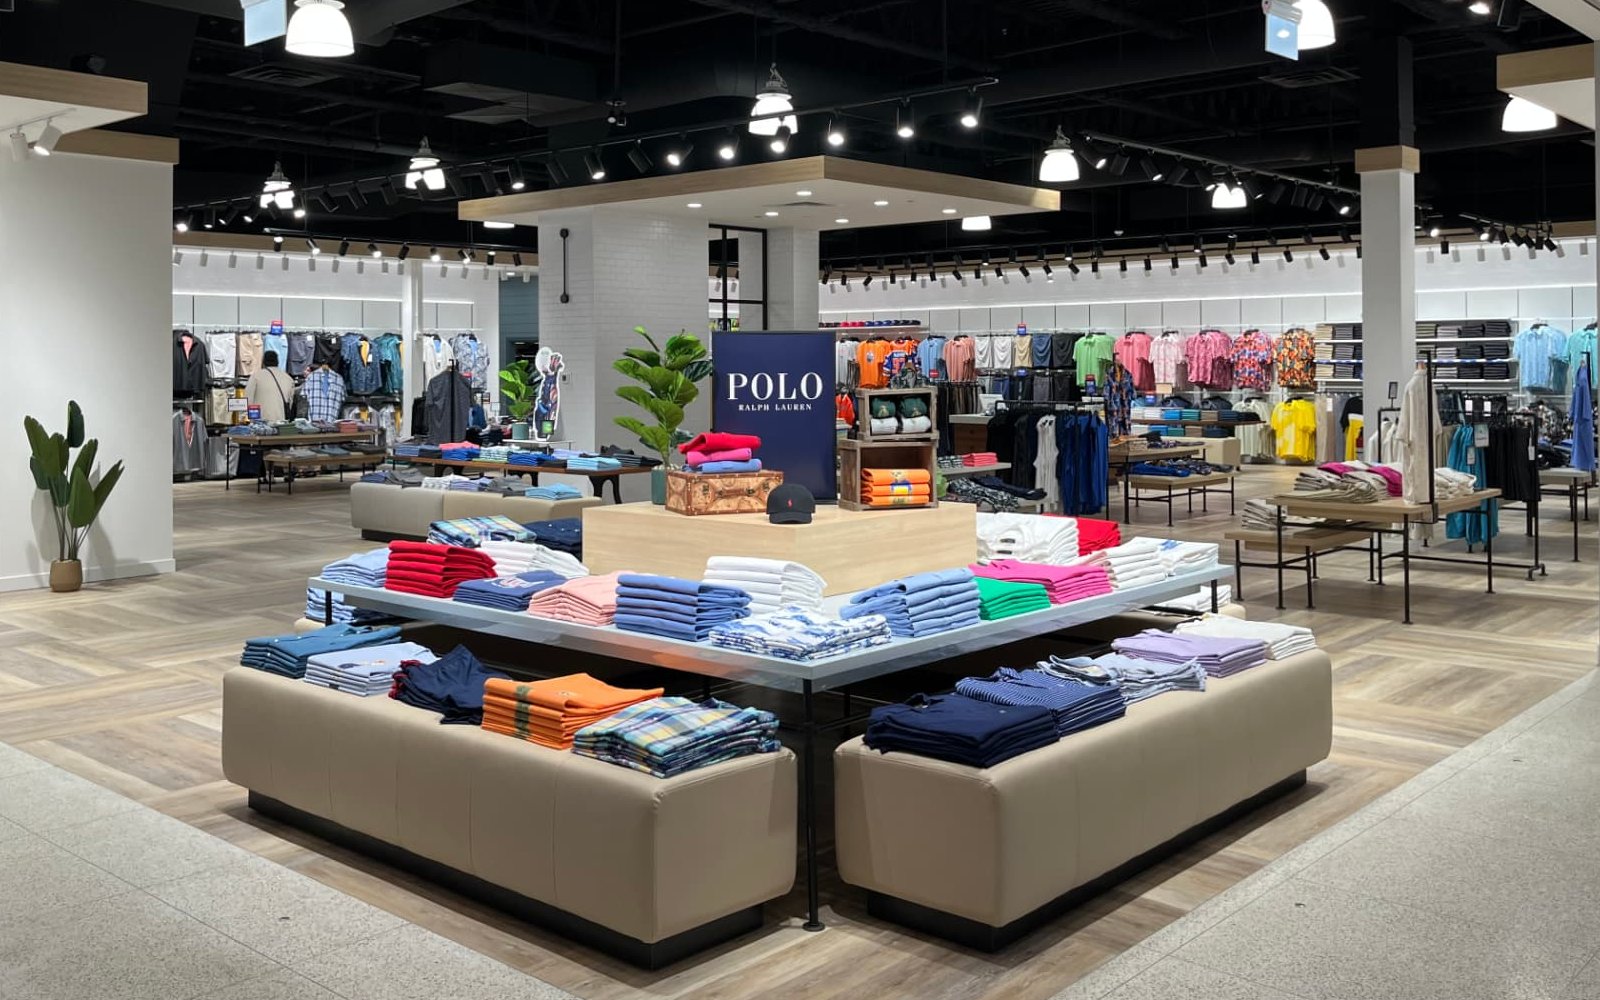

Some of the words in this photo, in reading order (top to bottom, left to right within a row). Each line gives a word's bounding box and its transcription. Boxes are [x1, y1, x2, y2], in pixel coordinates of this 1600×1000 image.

[727, 372, 823, 400] POLO
[738, 403, 769, 411] RALPH
[775, 403, 812, 411] LAUREN
